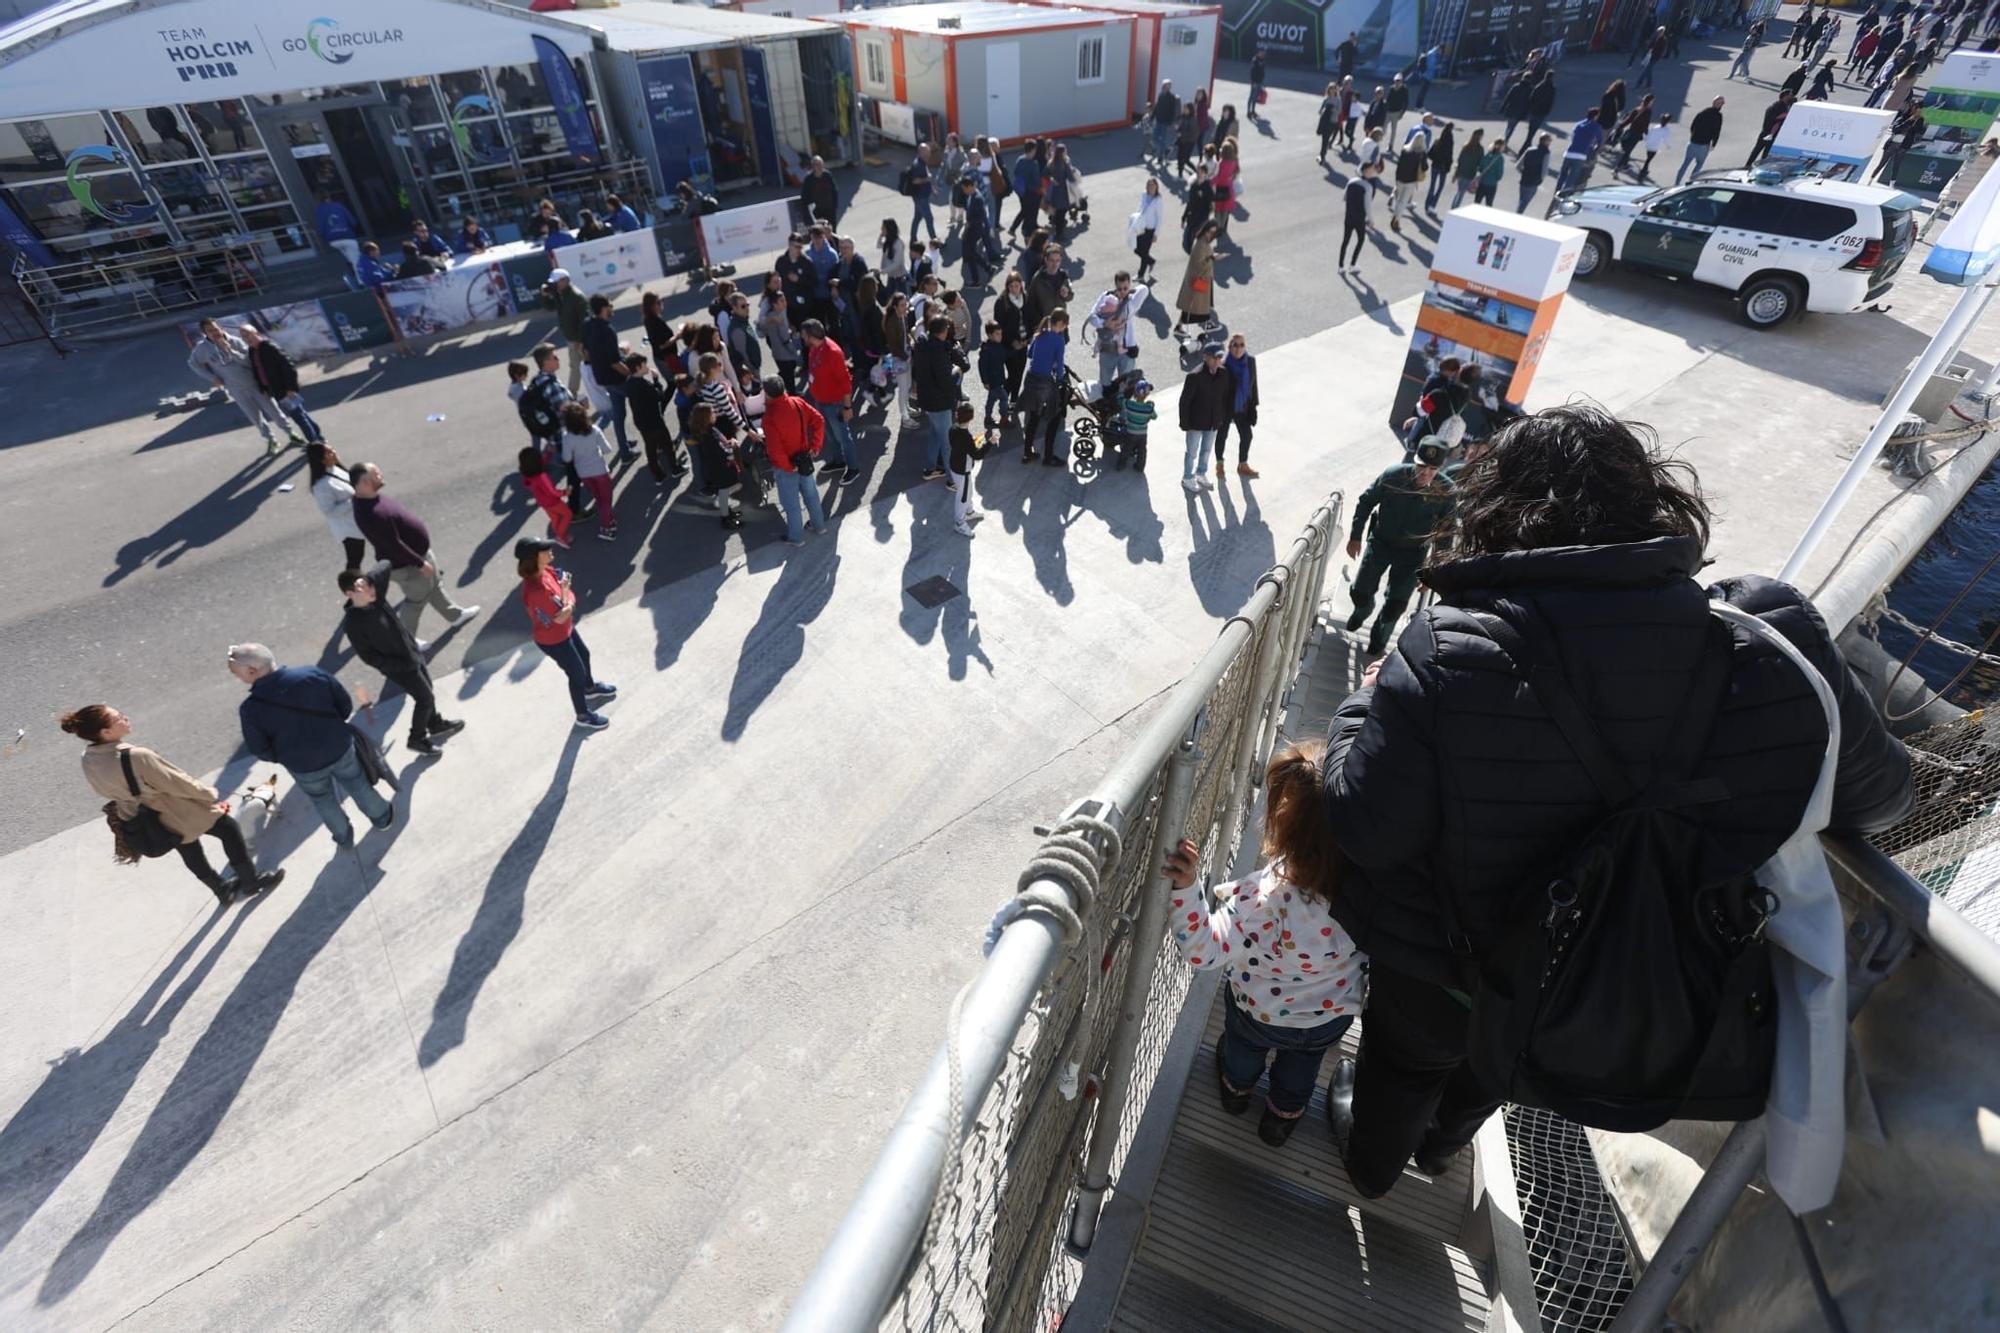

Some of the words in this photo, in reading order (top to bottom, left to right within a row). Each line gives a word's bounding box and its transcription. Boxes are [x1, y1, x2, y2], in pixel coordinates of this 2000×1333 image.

[159, 28, 206, 42] TEAM
[1257, 21, 1308, 43] GUYOT
[282, 38, 307, 52] GO
[326, 29, 403, 48] CIRCULAR
[166, 40, 254, 62] HOLCIM
[176, 62, 238, 82] PRB
[1801, 128, 1844, 141] BOATS
[1842, 235, 1864, 248] 062
[1717, 242, 1759, 258] GUARDIA
[1722, 254, 1744, 265] CIVIL
